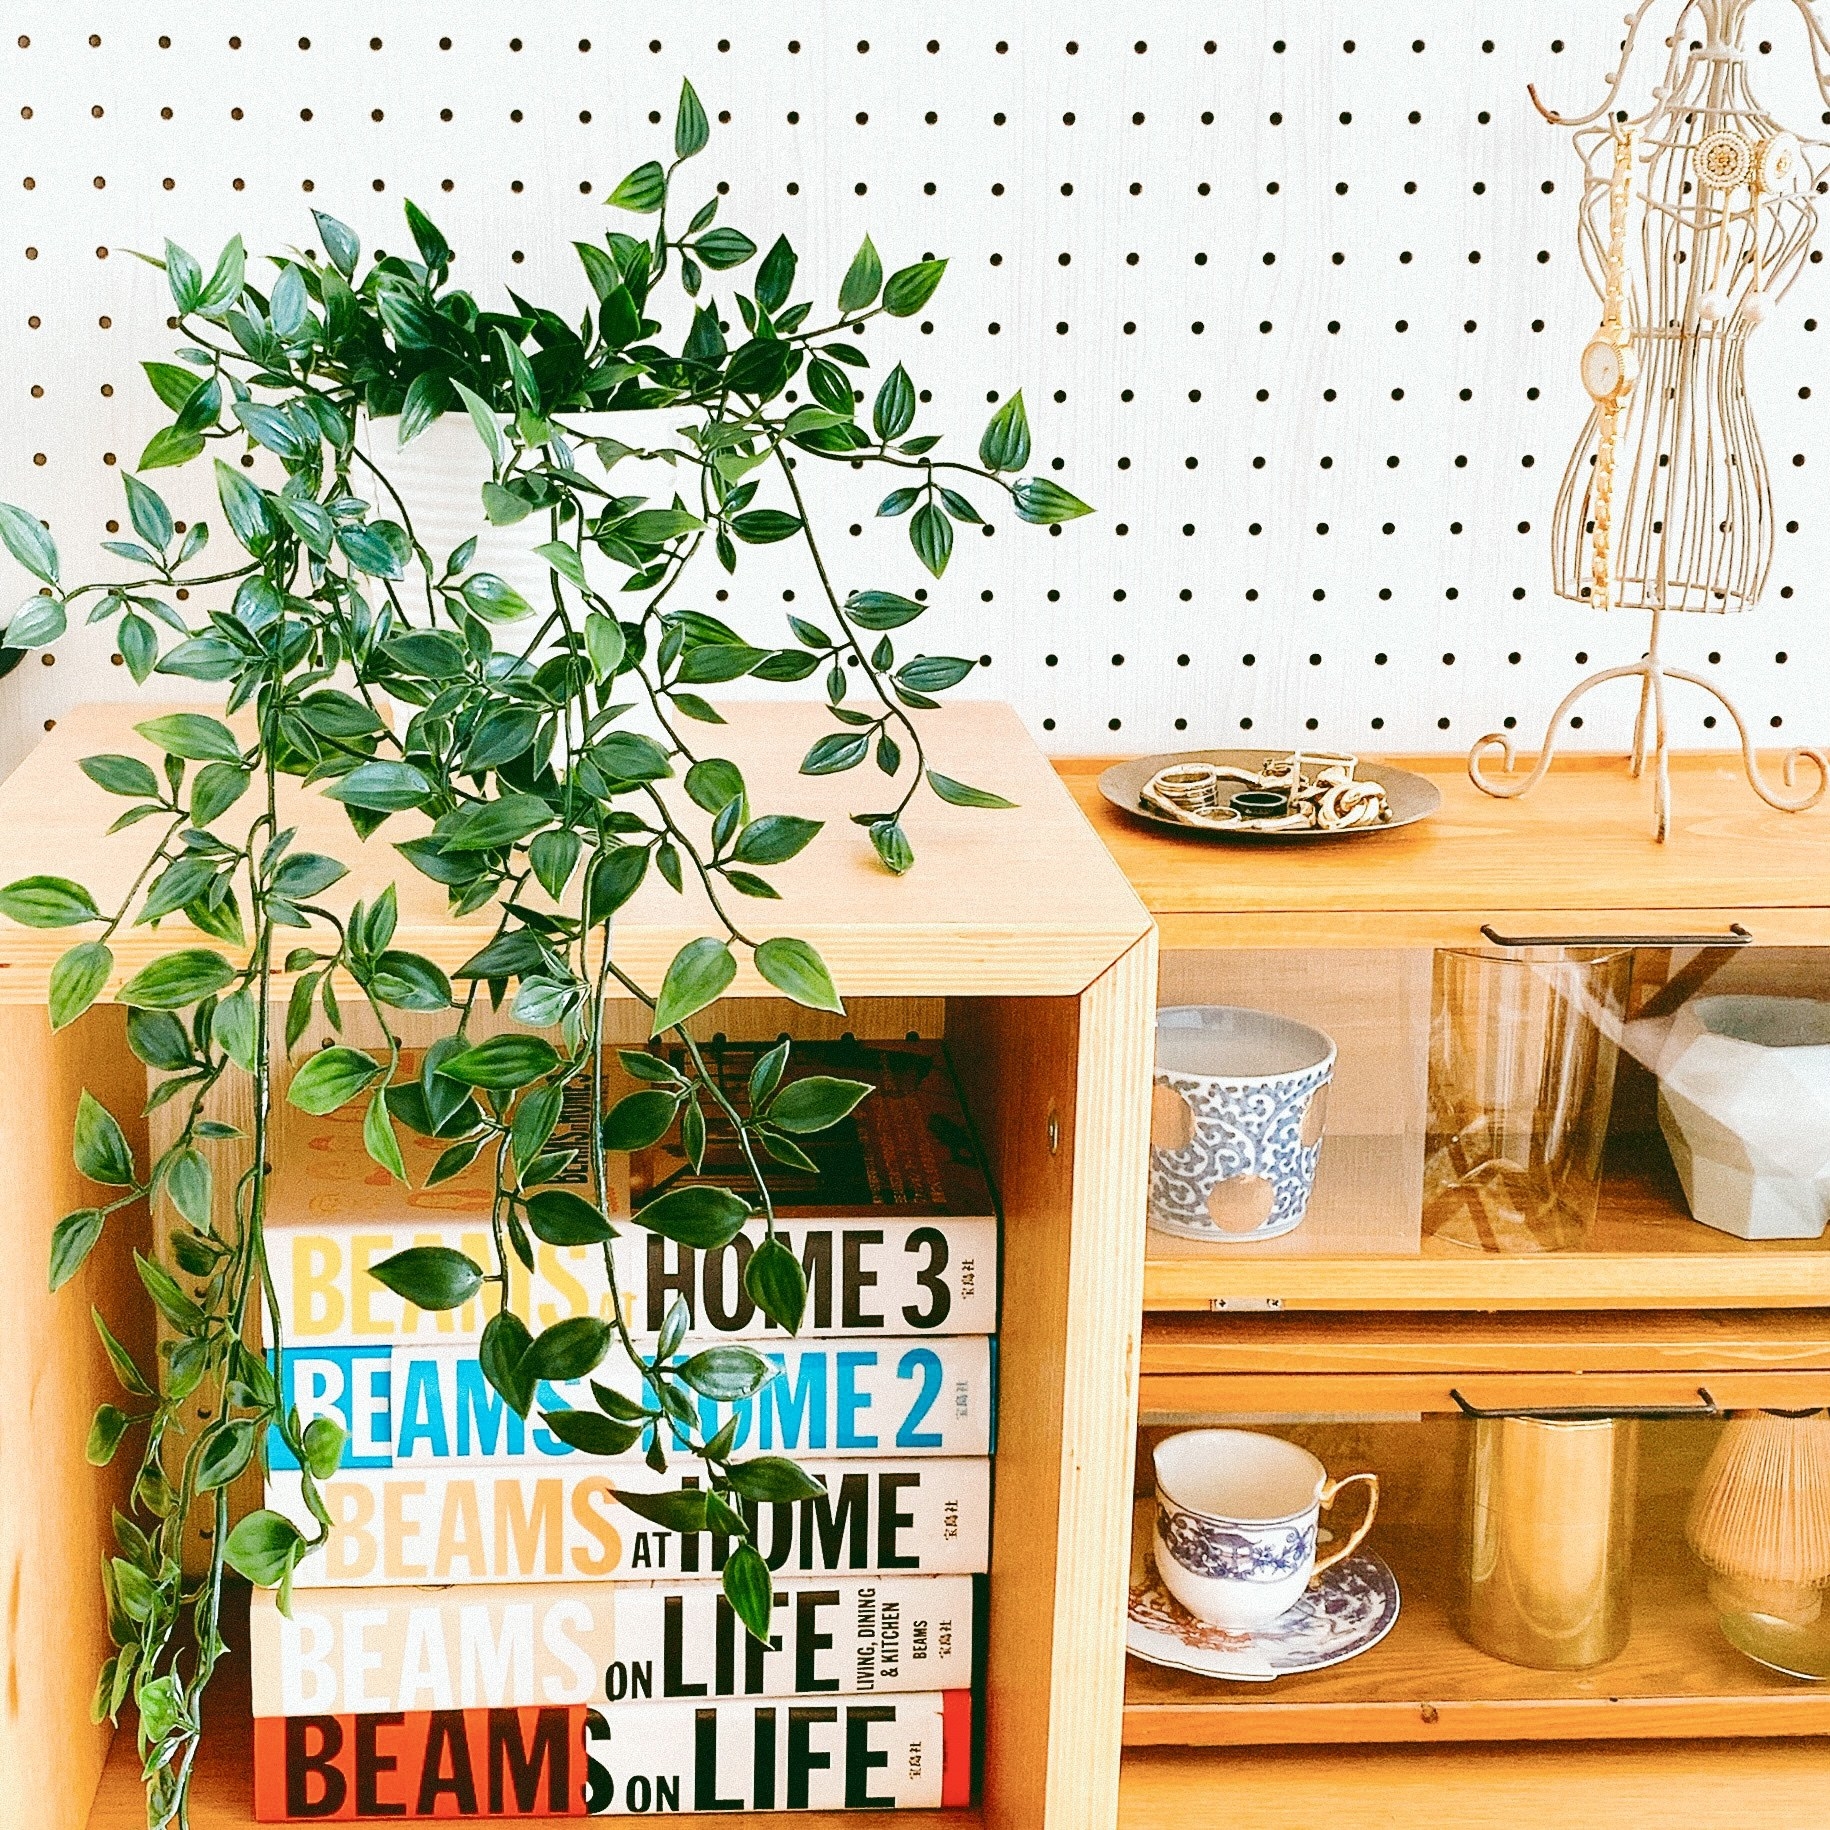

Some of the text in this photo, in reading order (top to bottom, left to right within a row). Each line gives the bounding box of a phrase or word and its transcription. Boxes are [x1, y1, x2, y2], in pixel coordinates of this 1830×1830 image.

[902, 1227, 951, 1329] 3
[895, 1348, 942, 1449] 2
[325, 1475, 622, 1579] BEAMS
[632, 1532, 671, 1568] AT
[281, 1590, 840, 1717] BEAMS ON LIFE
[856, 1588, 878, 1690] LIVING, DINING
[880, 1602, 899, 1677] & KITCHEN
[912, 1620, 928, 1659] BEAMS
[285, 1706, 896, 1818] BEAMS ON LIFE
